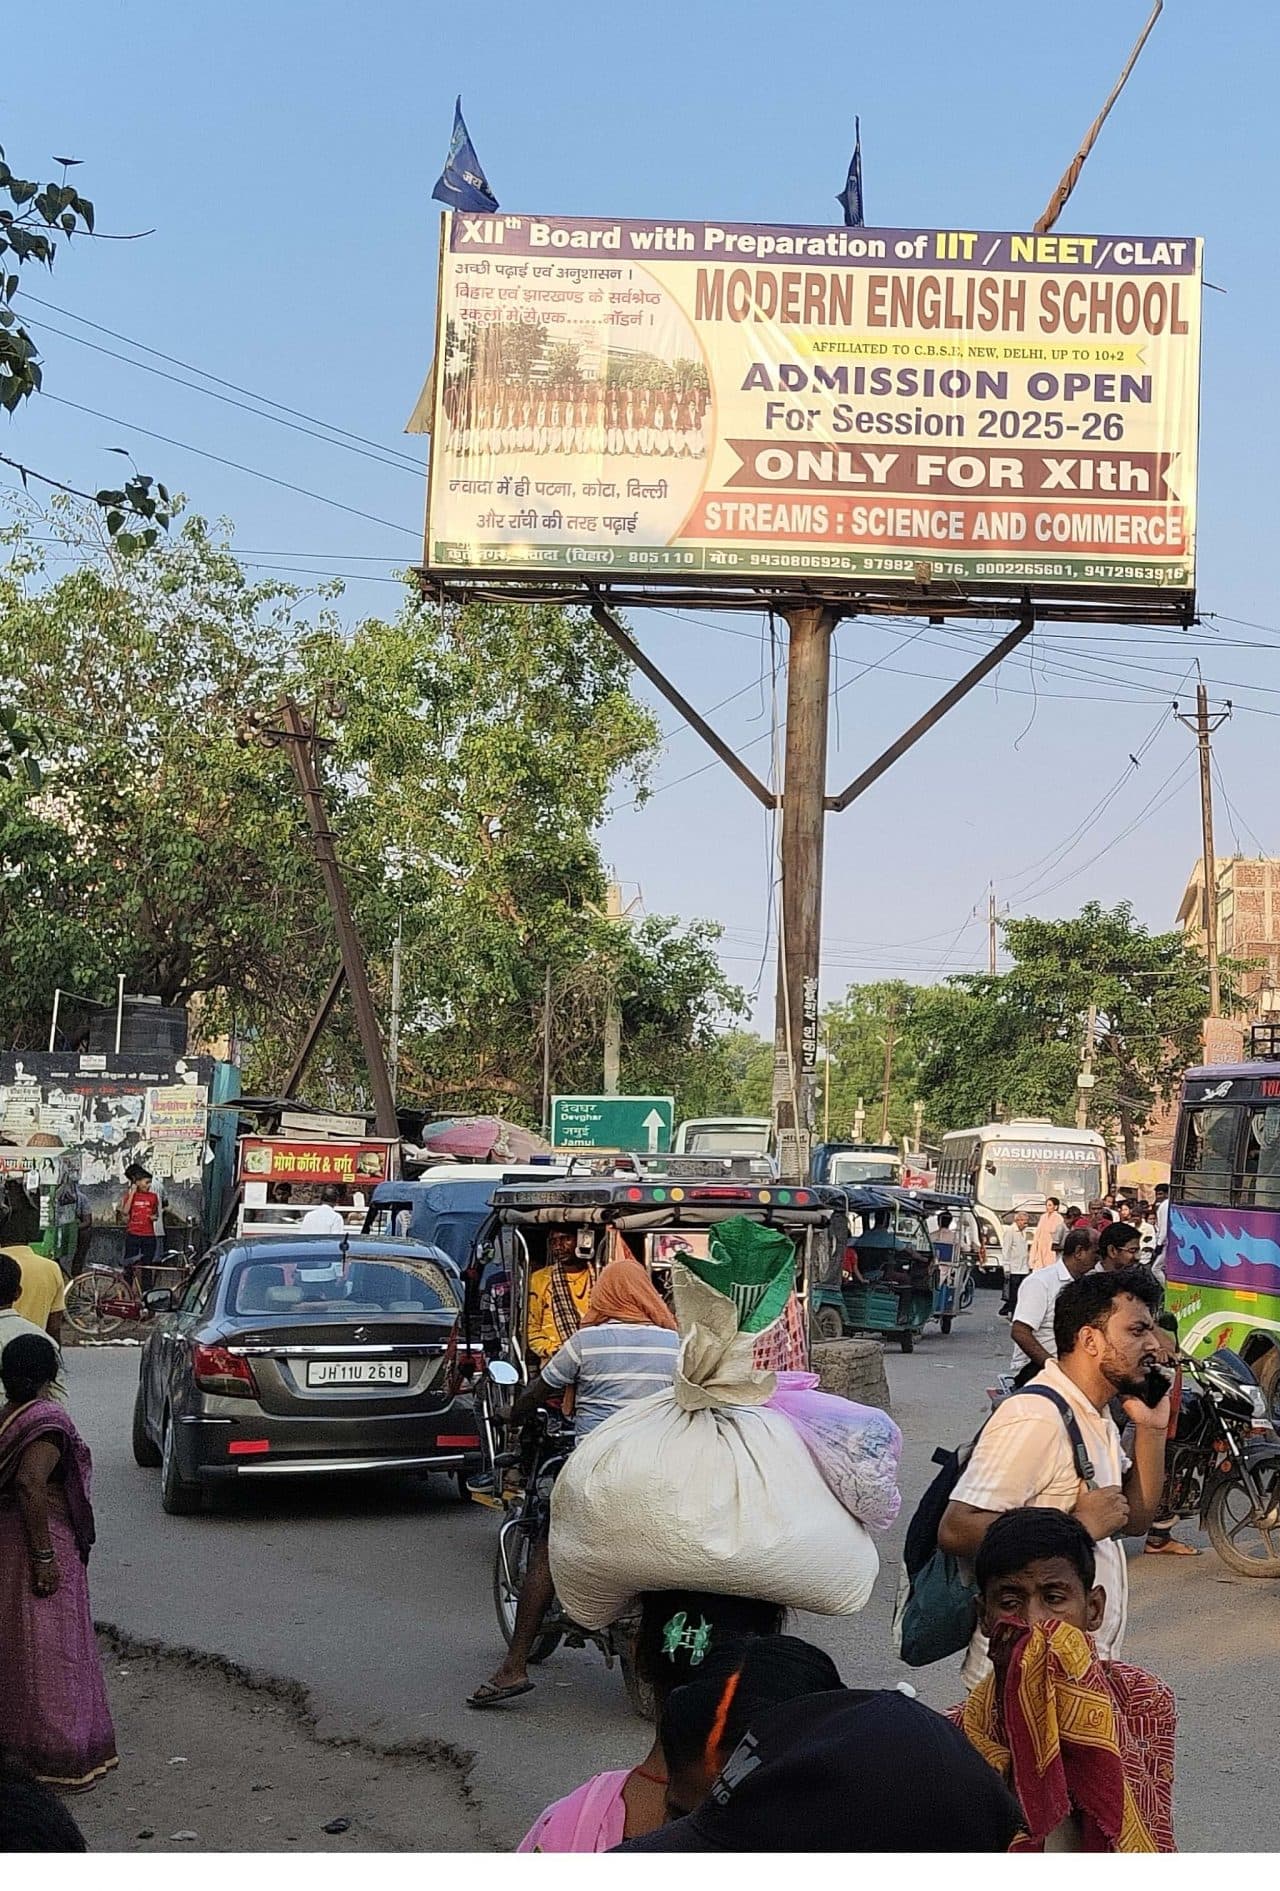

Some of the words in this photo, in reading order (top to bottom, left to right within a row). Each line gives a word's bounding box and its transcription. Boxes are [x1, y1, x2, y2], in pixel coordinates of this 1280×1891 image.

[529, 223, 621, 249] Board
[630, 226, 695, 251] with
[704, 227, 886, 258] Preparation
[894, 235, 929, 259] of
[936, 232, 978, 260] IIT
[455, 260, 490, 275] अच्छी
[496, 262, 527, 279] पढ़ाई
[533, 264, 552, 277] एवं
[556, 267, 621, 284] अनुशासन
[499, 285, 521, 300] एवं
[589, 288, 604, 303] के
[694, 268, 854, 327] MODERN
[867, 274, 1026, 332] ENGLISH
[1039, 279, 1189, 336] SCHOOL
[812, 341, 888, 355] AFFILIATED
[892, 344, 910, 355] TO
[1003, 348, 1047, 361] DELHI,
[1052, 349, 1069, 360] UP
[1072, 349, 1090, 361] TO
[1095, 350, 1124, 361] 10+2
[740, 362, 1008, 400] ADMISSION
[1027, 371, 1152, 404] OPEN
[765, 401, 821, 432] For
[832, 403, 965, 438] Session
[978, 409, 1124, 441] 2025-26
[754, 448, 900, 484] ONLY
[917, 454, 1024, 488] FOR
[1040, 457, 1150, 492] XIth
[496, 476, 512, 496] में
[514, 475, 530, 498] ही
[626, 478, 669, 500] दिल्ली
[476, 508, 505, 529] और
[508, 509, 539, 530] रांची
[542, 509, 564, 531] की
[567, 514, 598, 532] तरह
[603, 511, 639, 536] पढ़ाई
[704, 501, 829, 534] STREAMS
[851, 506, 965, 540] SCIENCE
[971, 511, 1027, 541] AND
[1035, 512, 1182, 545] COMMERCE
[628, 551, 694, 565] 805110
[561, 1113, 603, 1122] Devghar
[560, 1138, 595, 1146] Jamui
[992, 1146, 1096, 1161] VASUNDHARA
[318, 1366, 337, 1380] JH
[341, 1366, 362, 1379] 11U
[368, 1365, 402, 1379] 2618
